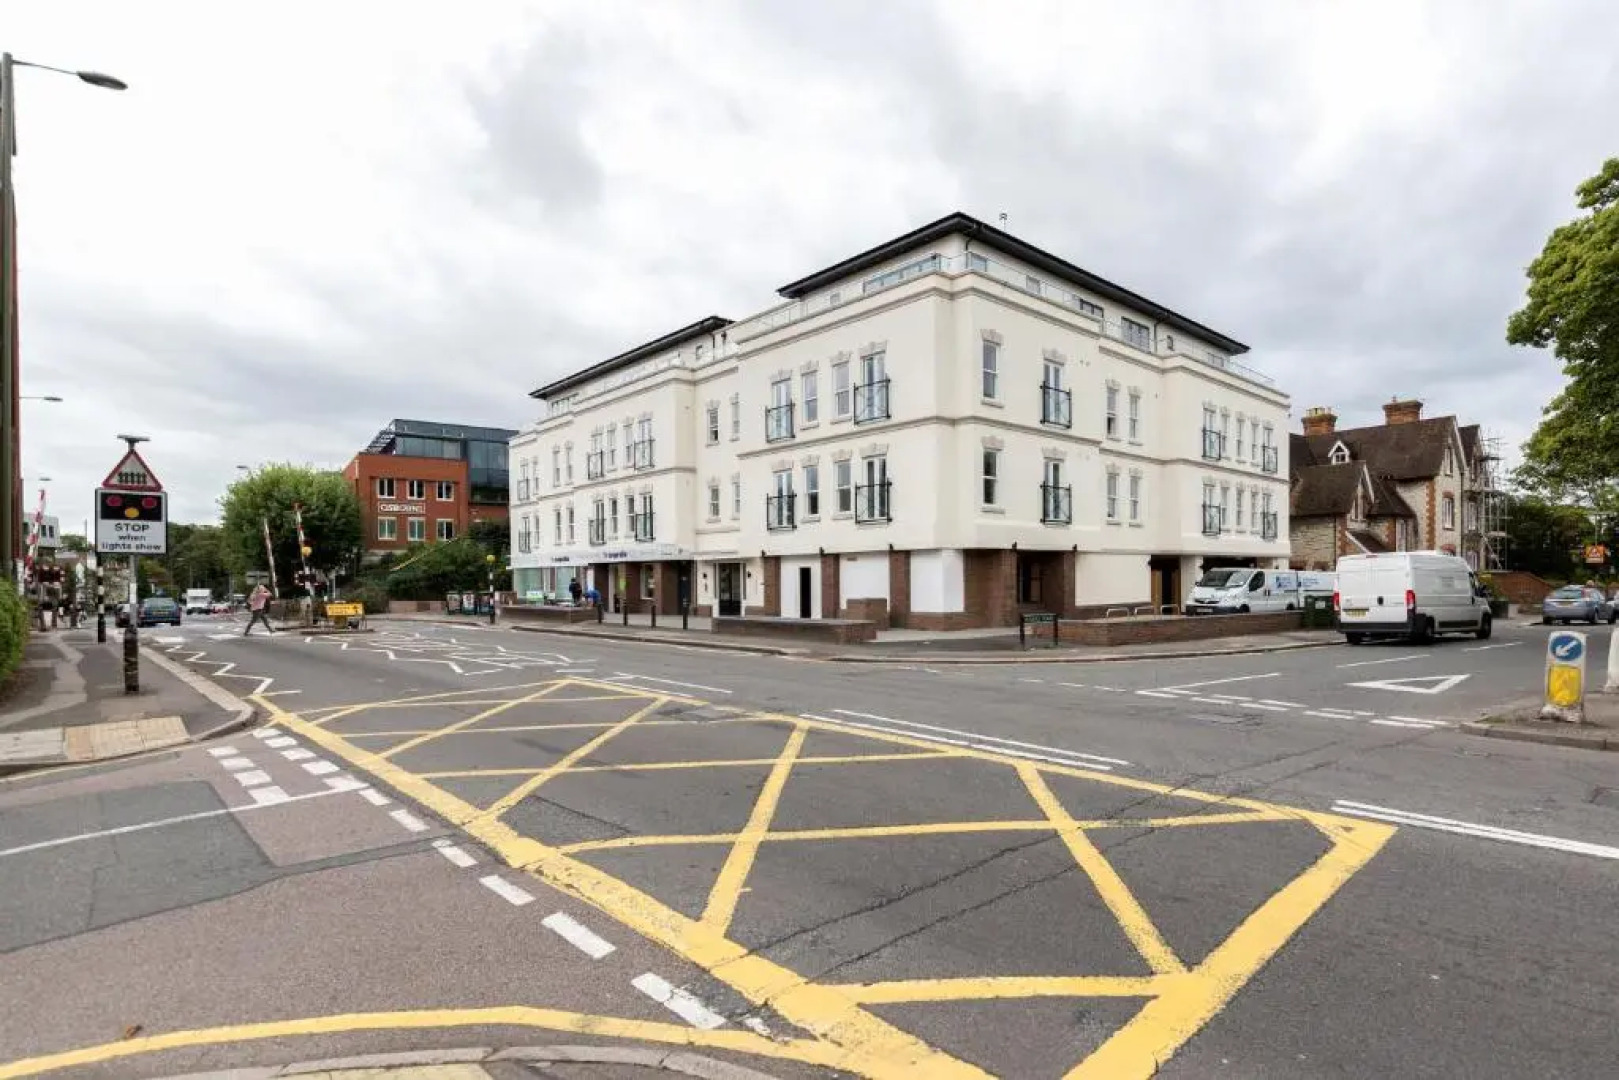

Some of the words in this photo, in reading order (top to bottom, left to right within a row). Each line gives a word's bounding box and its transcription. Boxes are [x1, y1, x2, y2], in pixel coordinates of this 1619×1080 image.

[115, 523, 150, 532] STOP
[118, 533, 146, 541] when
[102, 541, 132, 550] lights
[135, 543, 162, 551] show
